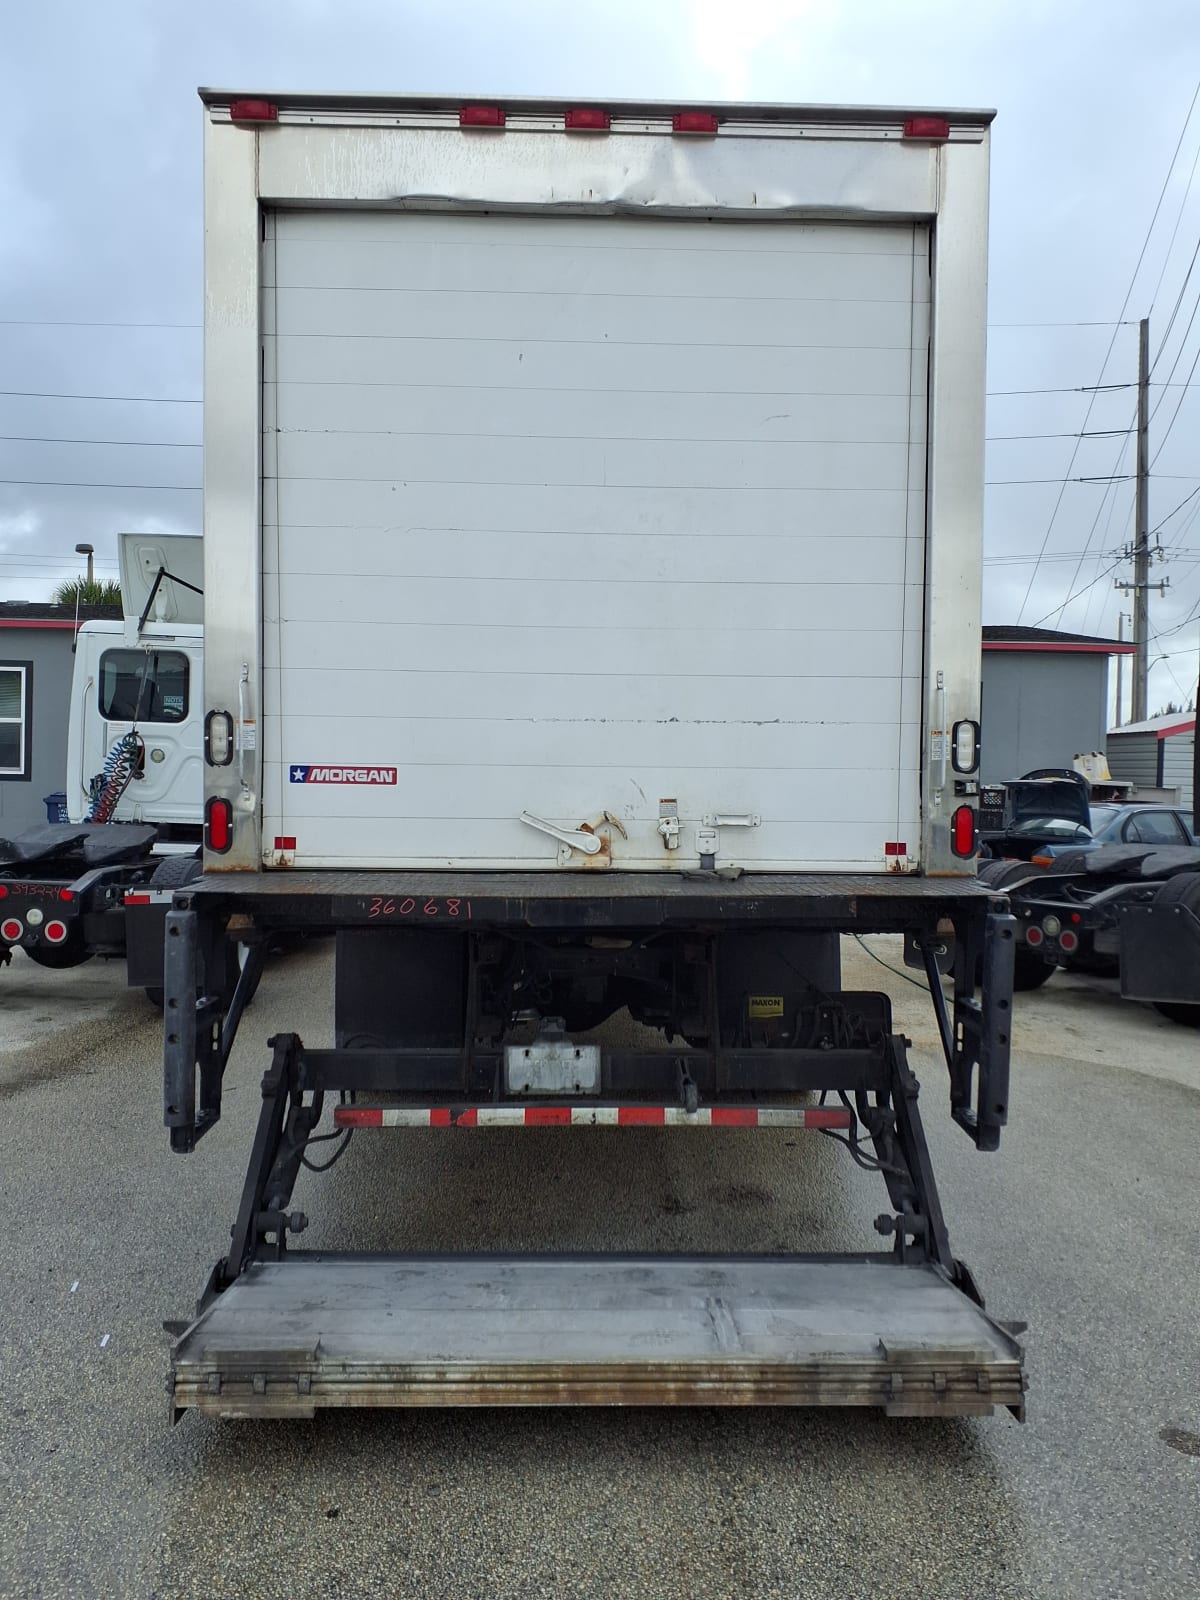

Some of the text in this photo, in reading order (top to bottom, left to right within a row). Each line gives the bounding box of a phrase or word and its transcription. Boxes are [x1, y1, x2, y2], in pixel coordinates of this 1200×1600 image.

[310, 769, 393, 782] MORGAN
[368, 897, 471, 919] 360681
[752, 999, 780, 1007] MAXON
